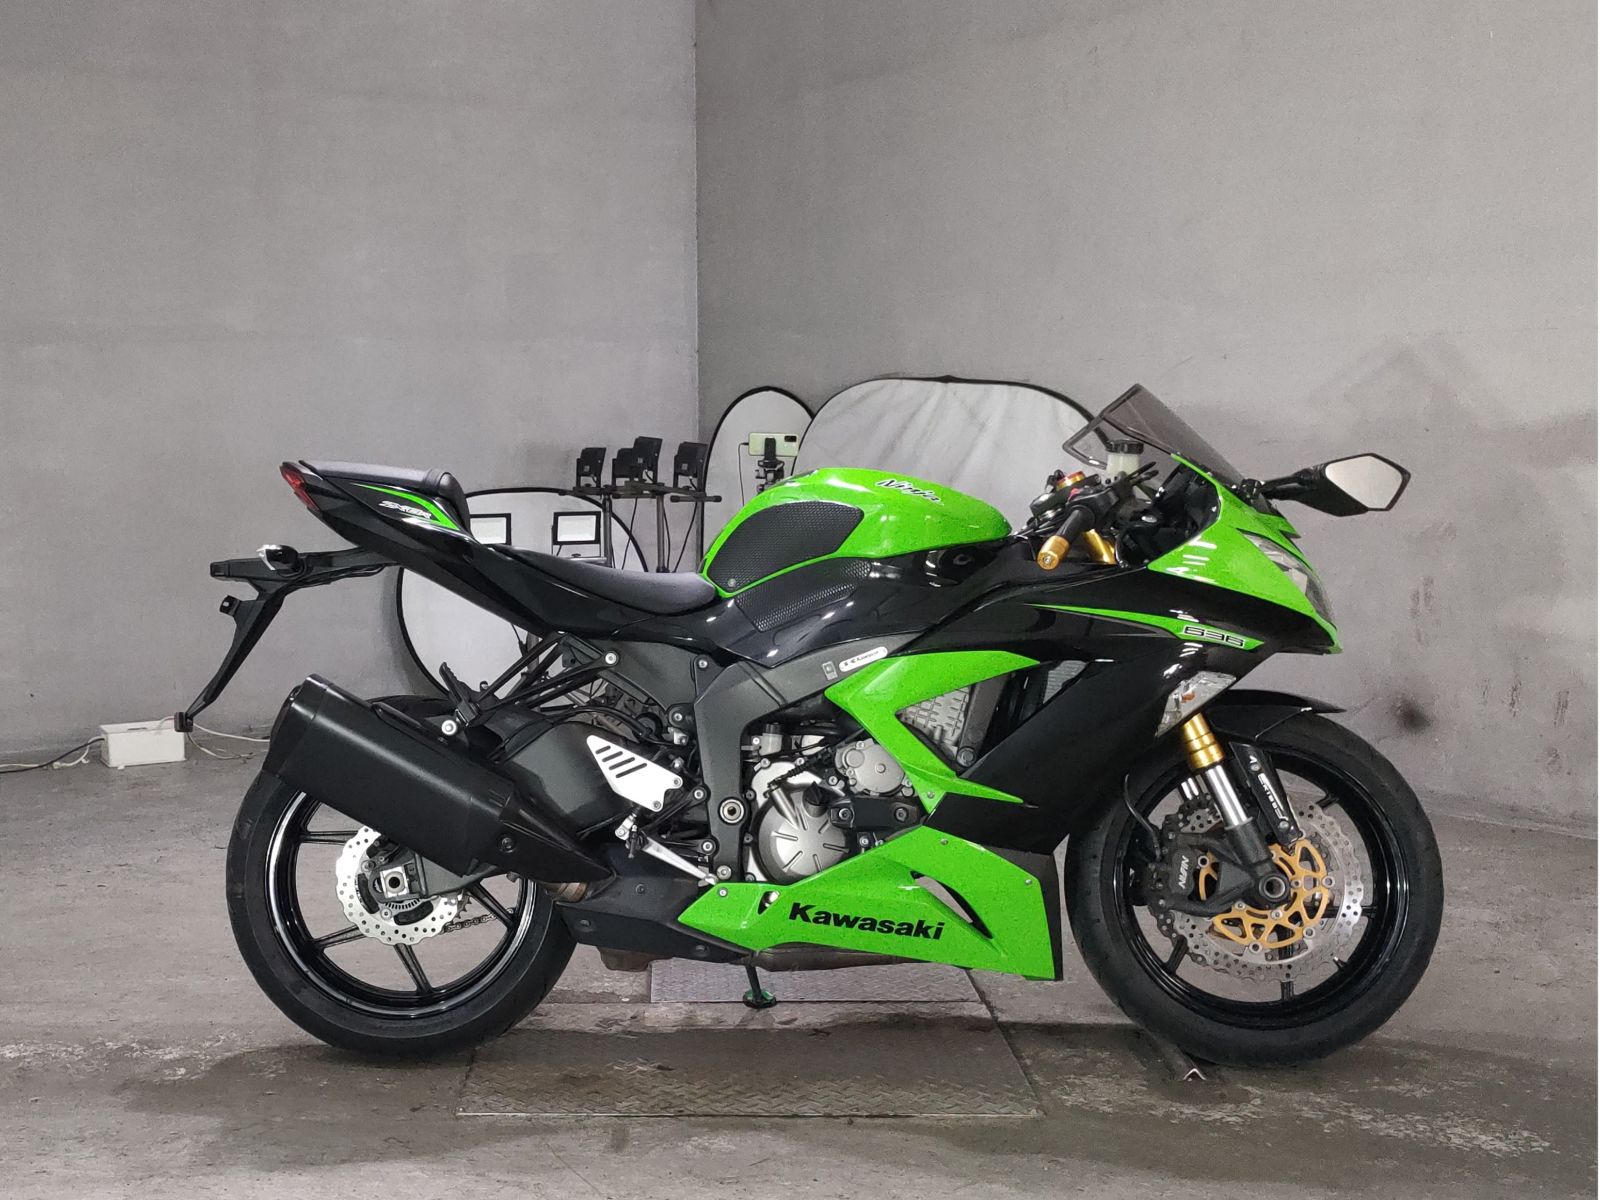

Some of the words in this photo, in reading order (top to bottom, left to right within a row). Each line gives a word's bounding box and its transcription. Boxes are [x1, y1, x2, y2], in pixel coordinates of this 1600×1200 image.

[875, 479, 943, 505] Ninja
[1184, 626, 1244, 648] 636
[788, 902, 945, 940] Kawasaki
